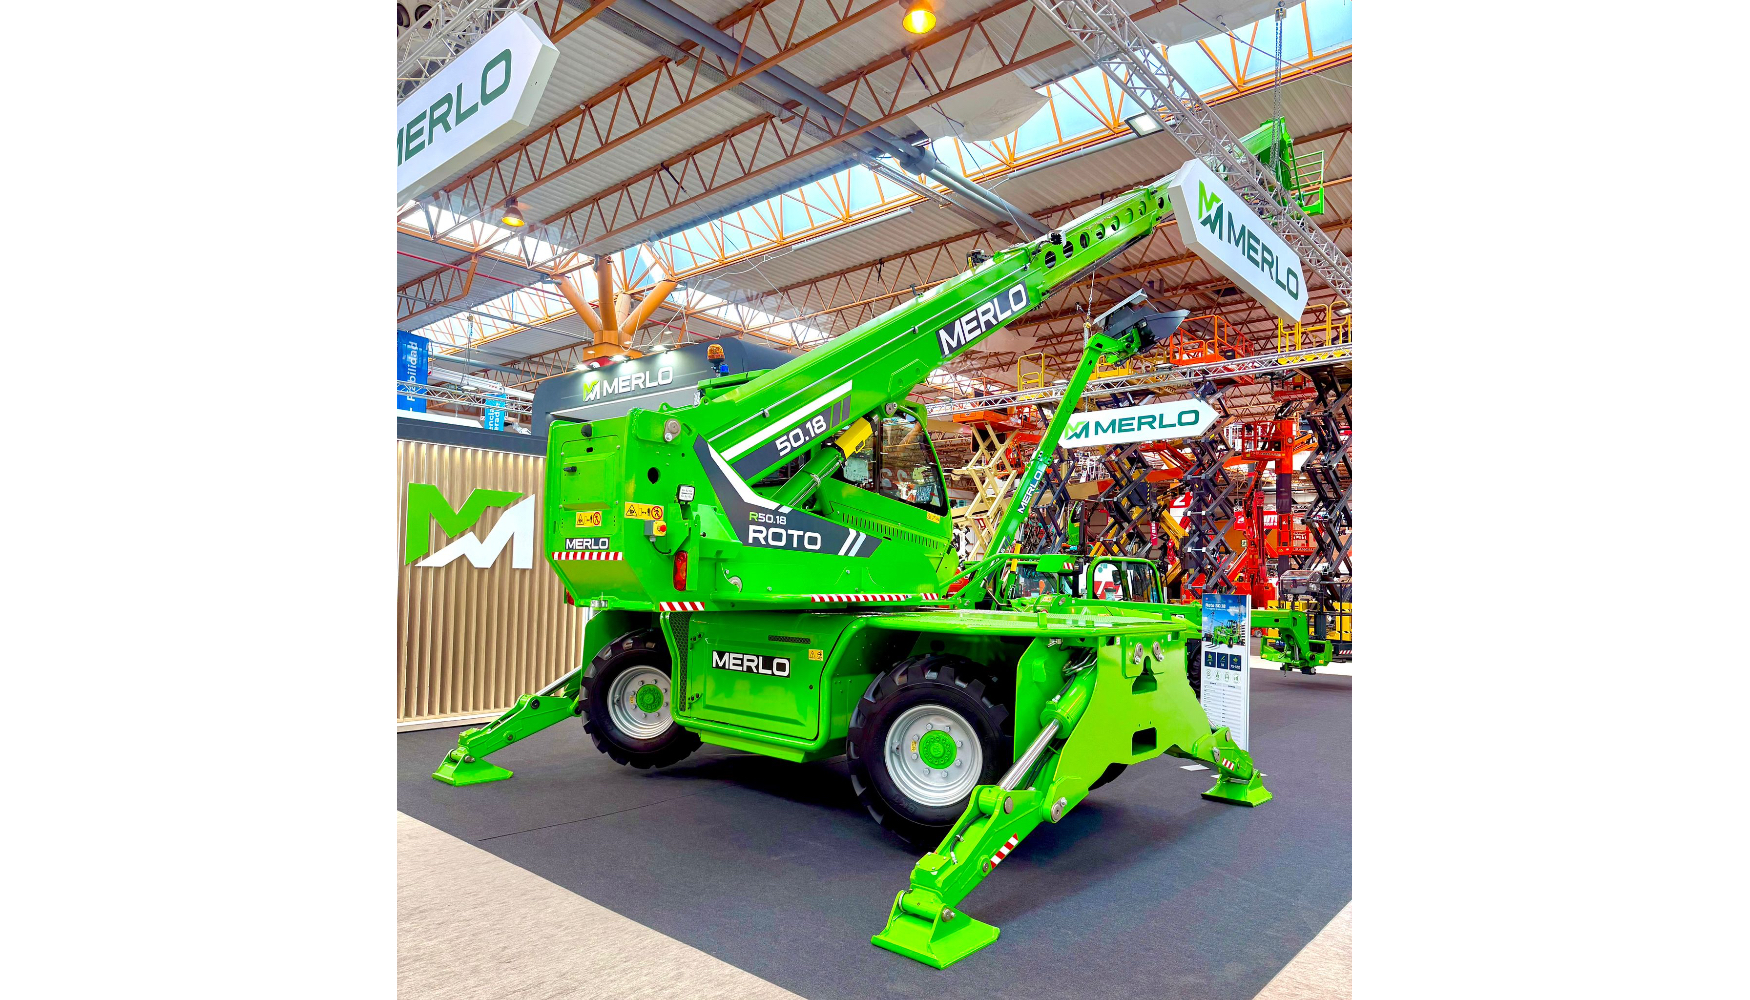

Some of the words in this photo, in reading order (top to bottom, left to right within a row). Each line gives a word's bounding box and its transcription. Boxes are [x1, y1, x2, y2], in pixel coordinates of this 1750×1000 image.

[1227, 210, 1298, 301] MERLO
[938, 283, 1027, 356] MERLO
[602, 366, 673, 397] MERLO
[775, 415, 827, 457] 50.18
[1094, 409, 1200, 436] MERLO
[1017, 470, 1043, 514] MERLO
[749, 512, 787, 525] R50.18
[565, 538, 609, 550] MERLO
[748, 525, 822, 550] ROTO
[712, 651, 790, 677] MERLO
